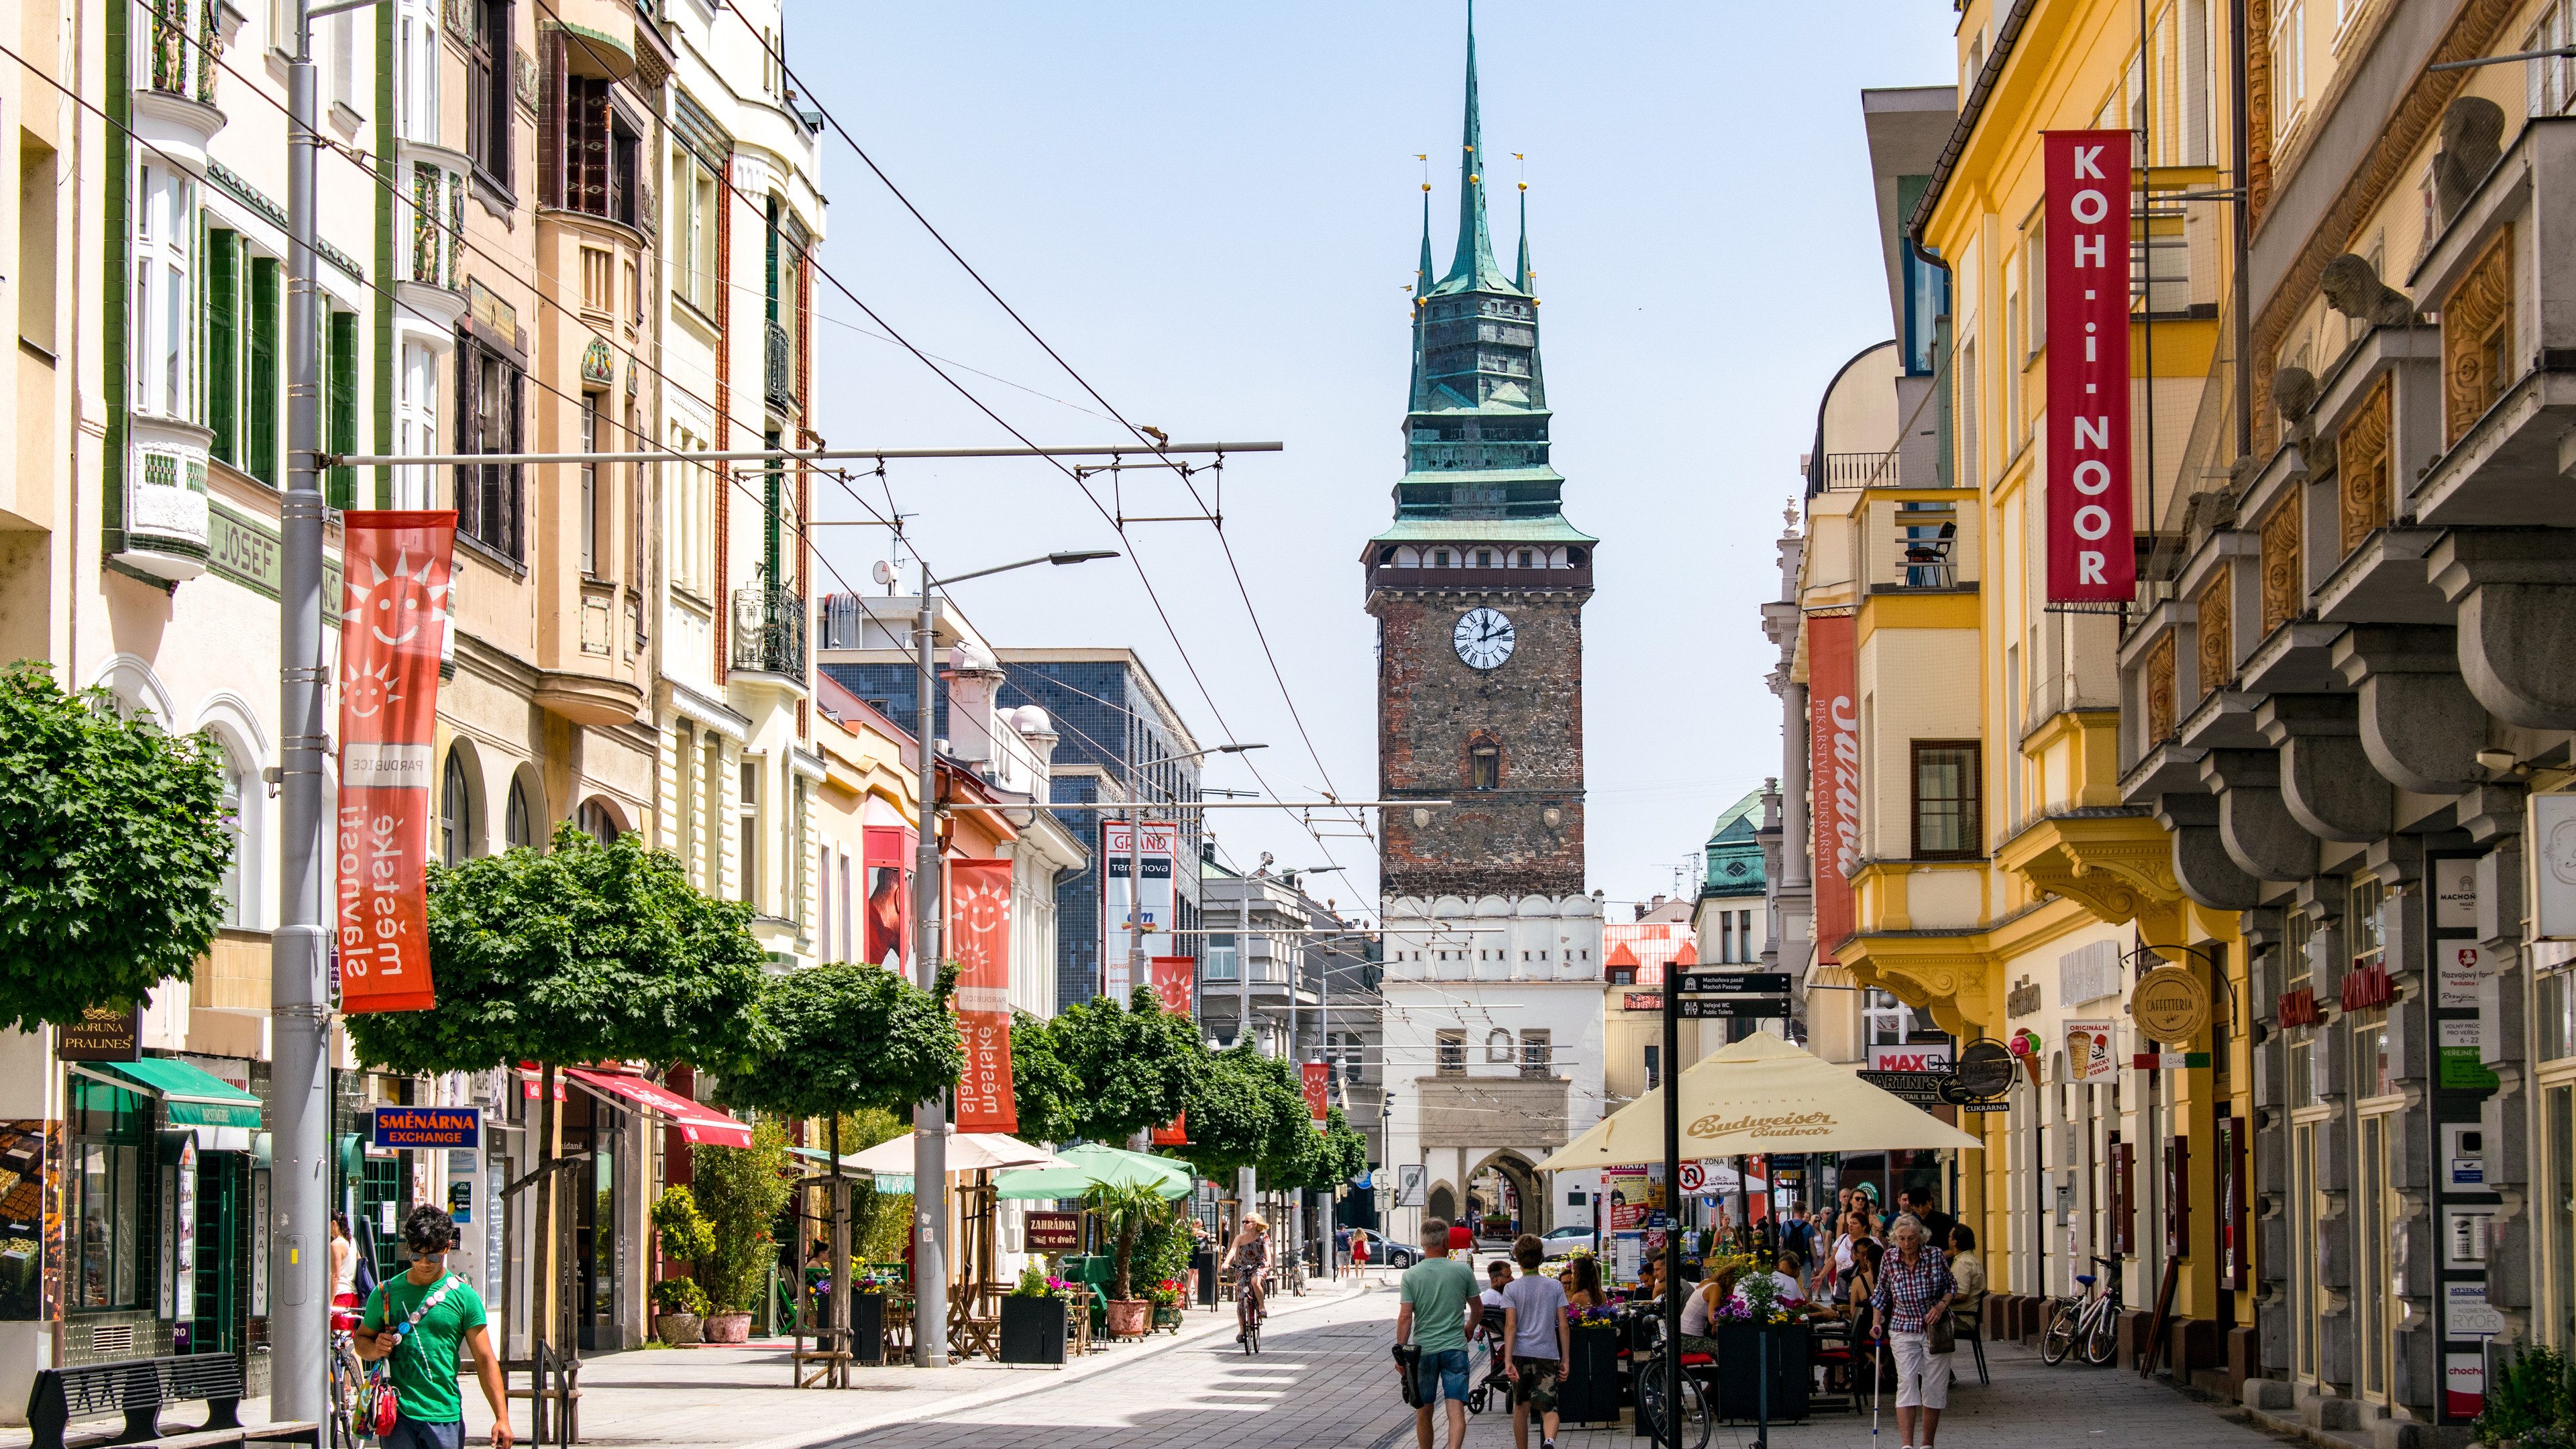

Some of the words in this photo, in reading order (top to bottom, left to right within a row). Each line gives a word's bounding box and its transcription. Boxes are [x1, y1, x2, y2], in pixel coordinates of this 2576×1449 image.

[219, 523, 273, 579] JOSEF
[1816, 700, 1828, 773] PEKAŘSTVÍ
[1818, 777, 1828, 787] A
[1819, 790, 1832, 879] CUKRÁŘSTVÍ
[2441, 971, 2476, 979] Rozvojový
[2146, 998, 2193, 1012] CAFFETTERIA
[65, 1038, 131, 1049] PRALINES
[2084, 1057, 2110, 1070] TURECKÝ
[2089, 1065, 2110, 1076] KEBAB
[1862, 1075, 1938, 1089] MARTINI'S
[1709, 1097, 1817, 1106] ORIGINAL
[1966, 1104, 2008, 1112] CUKRÁRNA
[379, 1111, 475, 1130] SMĚNÁRNA
[1686, 1112, 1838, 1139] Budweiser
[389, 1132, 462, 1142] EXCHANGE
[1750, 1125, 1833, 1138] Budvar
[1030, 1218, 1076, 1230] ZAHRÁDKA
[163, 1180, 172, 1307] POTRAVINY
[257, 1184, 266, 1305] POTRAVINY
[1057, 1235, 1076, 1244] dvoře
[2453, 1314, 2498, 1328] RYOR
